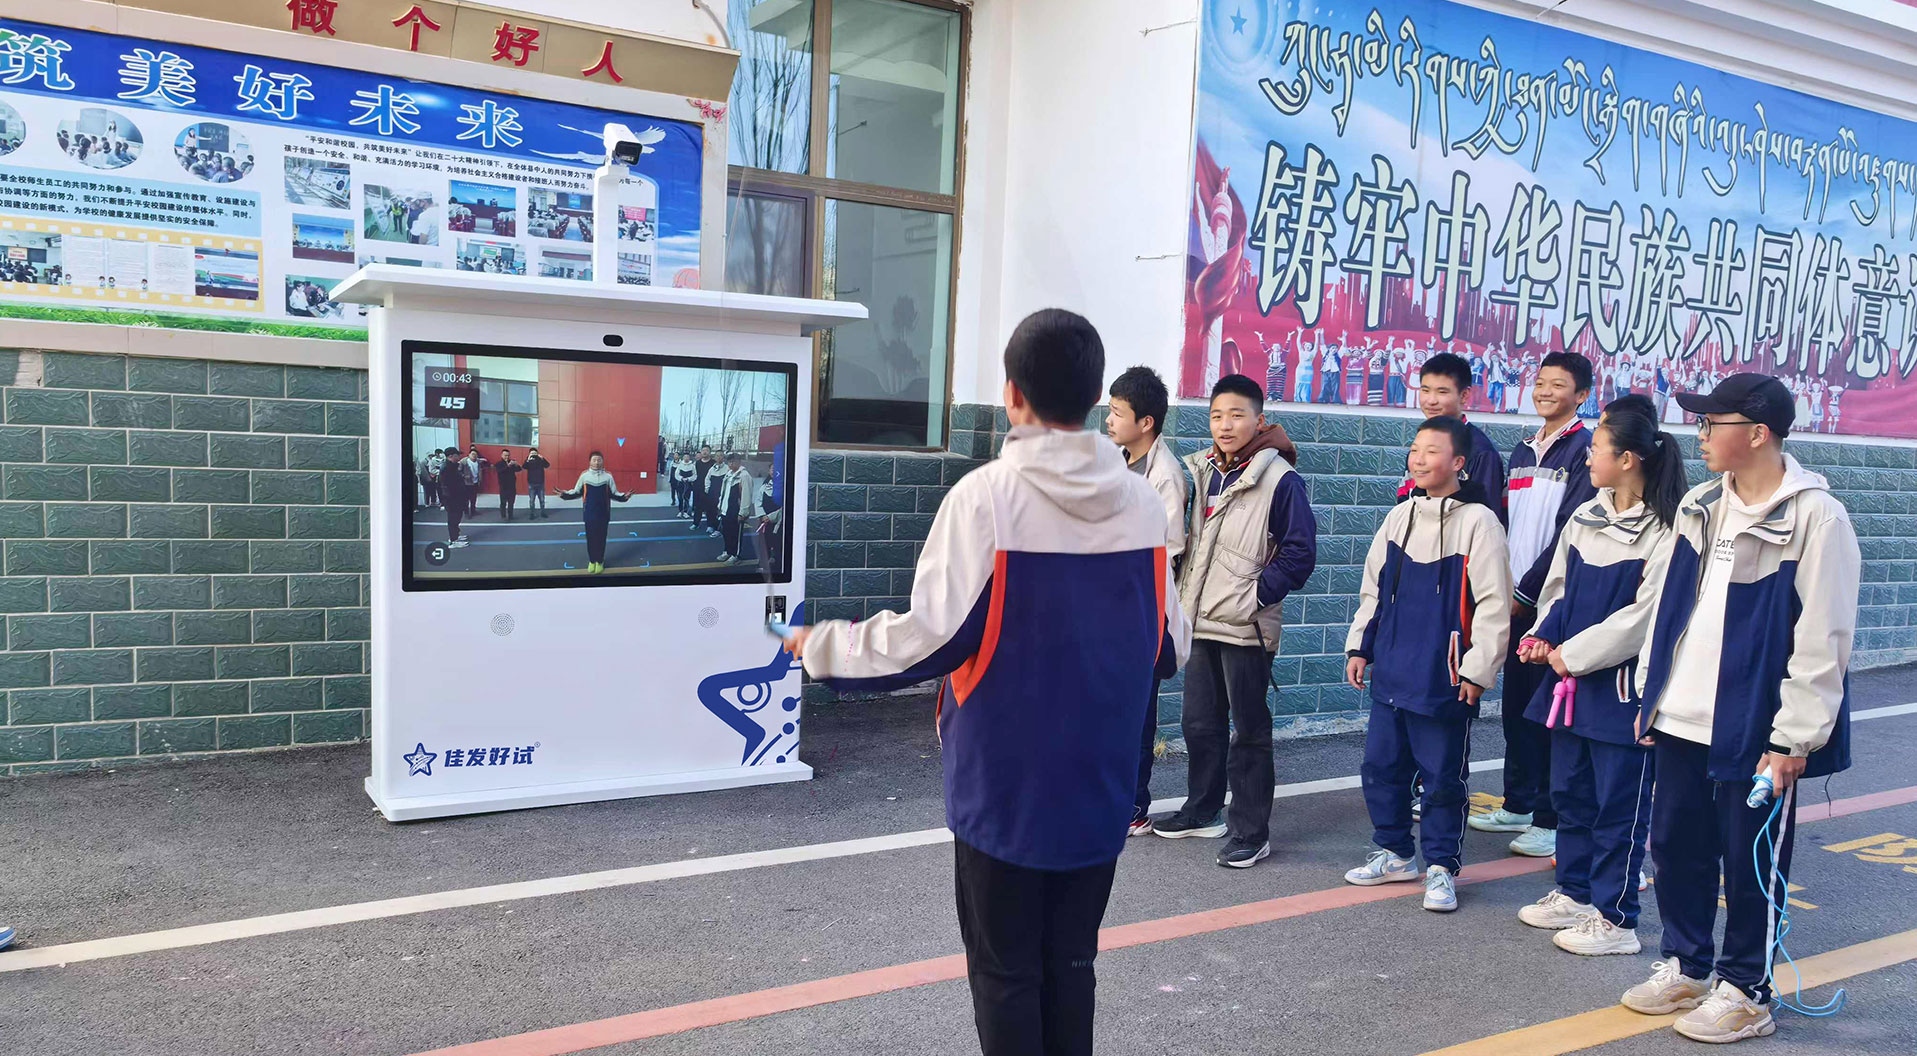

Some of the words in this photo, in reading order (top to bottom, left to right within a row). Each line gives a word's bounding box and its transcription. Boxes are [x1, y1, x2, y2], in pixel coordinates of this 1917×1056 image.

[286, 0, 624, 83] 做个好人
[0, 28, 523, 148] 筑美好未来
[443, 373, 472, 383] 00:43
[440, 397, 466, 409] 45
[444, 746, 535, 767] 佳发好试
